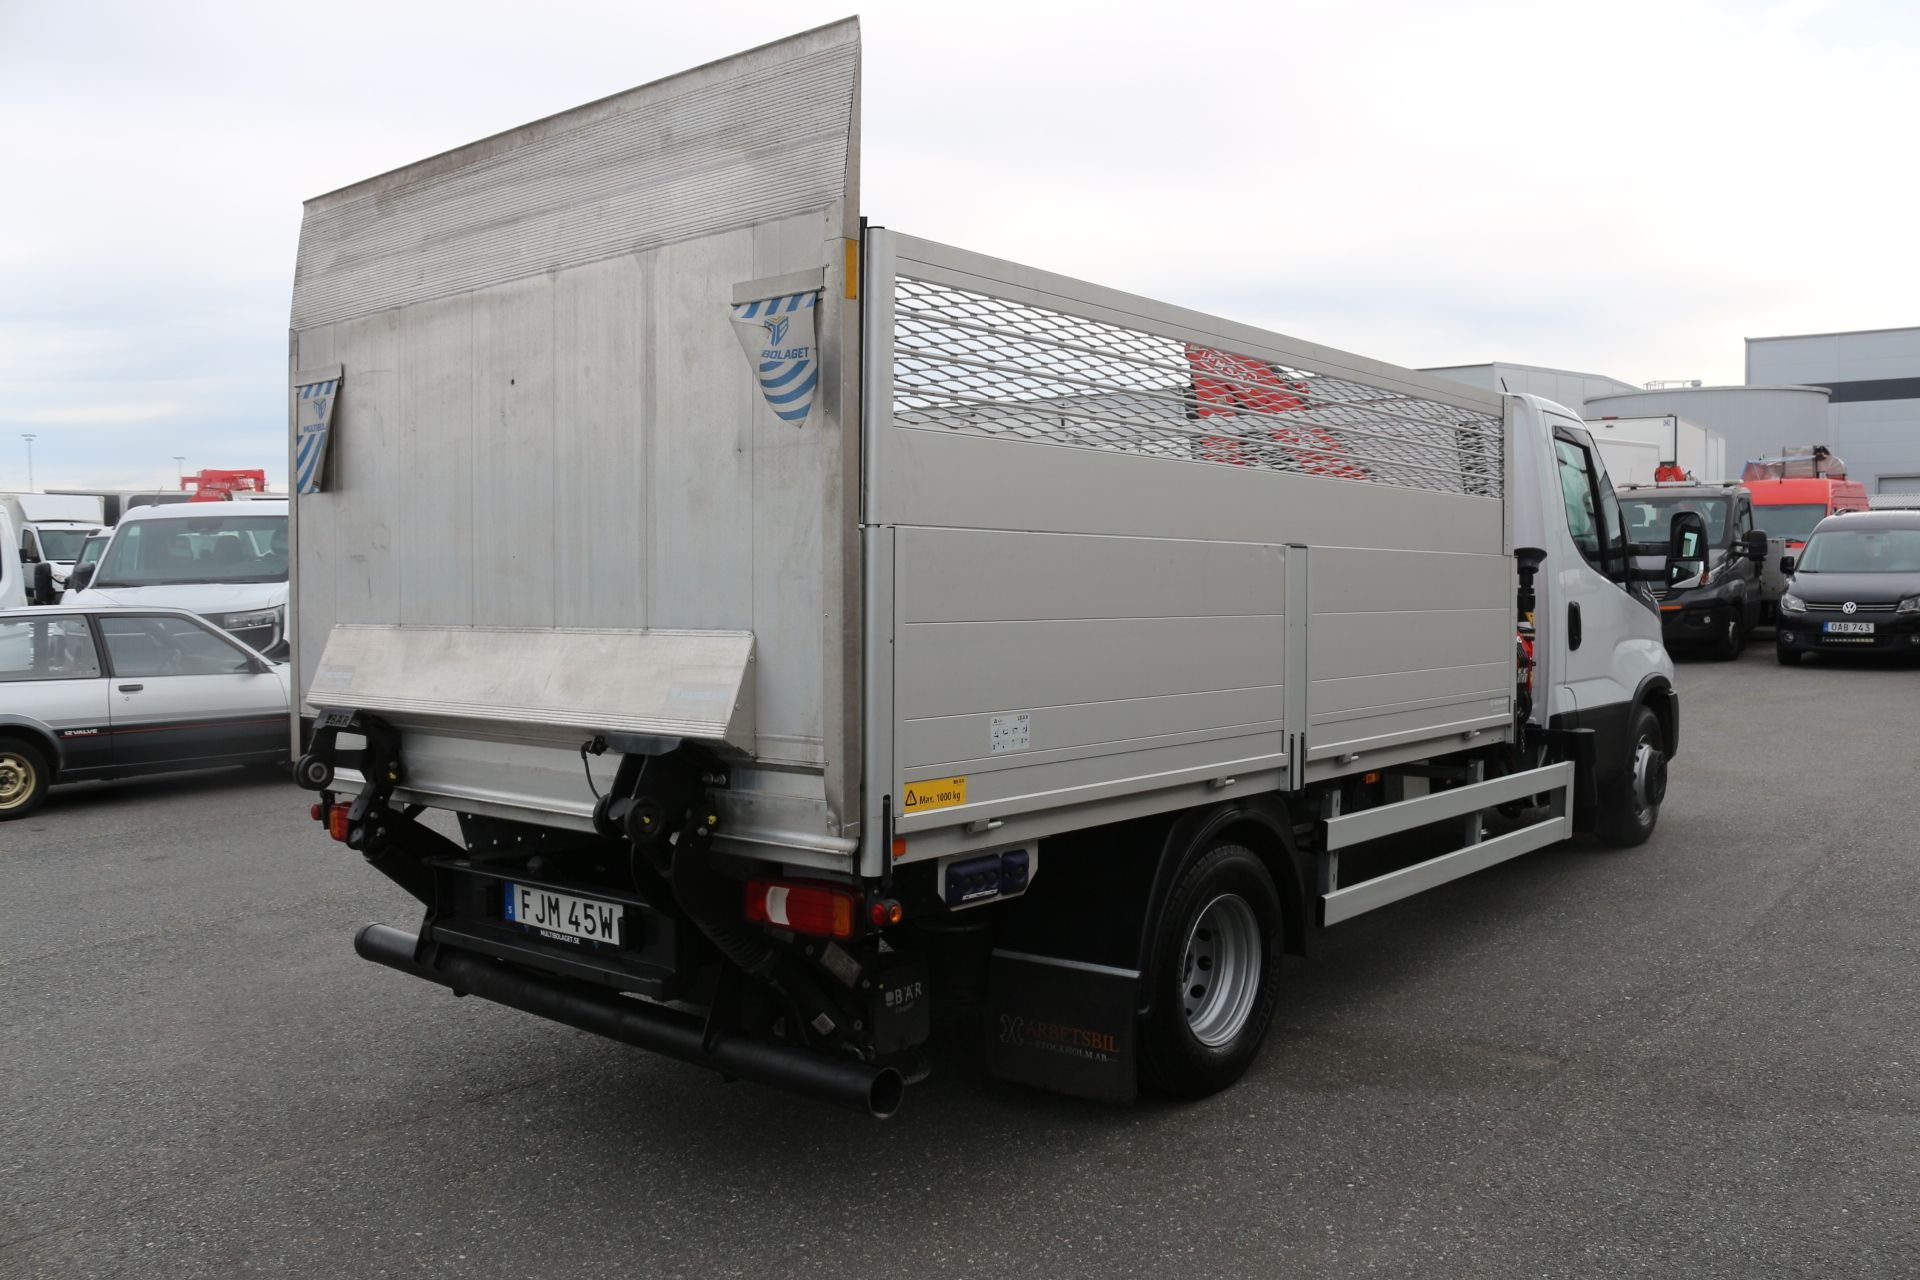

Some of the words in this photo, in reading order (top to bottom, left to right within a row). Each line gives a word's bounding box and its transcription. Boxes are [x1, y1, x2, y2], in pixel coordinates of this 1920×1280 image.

[1831, 623, 1849, 631] OAB
[1852, 623, 1871, 631] 743
[919, 795, 935, 805] Max.
[936, 792, 952, 802] 1000
[952, 791, 961, 801] kg
[521, 889, 561, 928] FJM
[568, 901, 613, 940] 45W
[895, 981, 923, 1005] BÄR
[1024, 1021, 1120, 1053] ARBETSBIL
